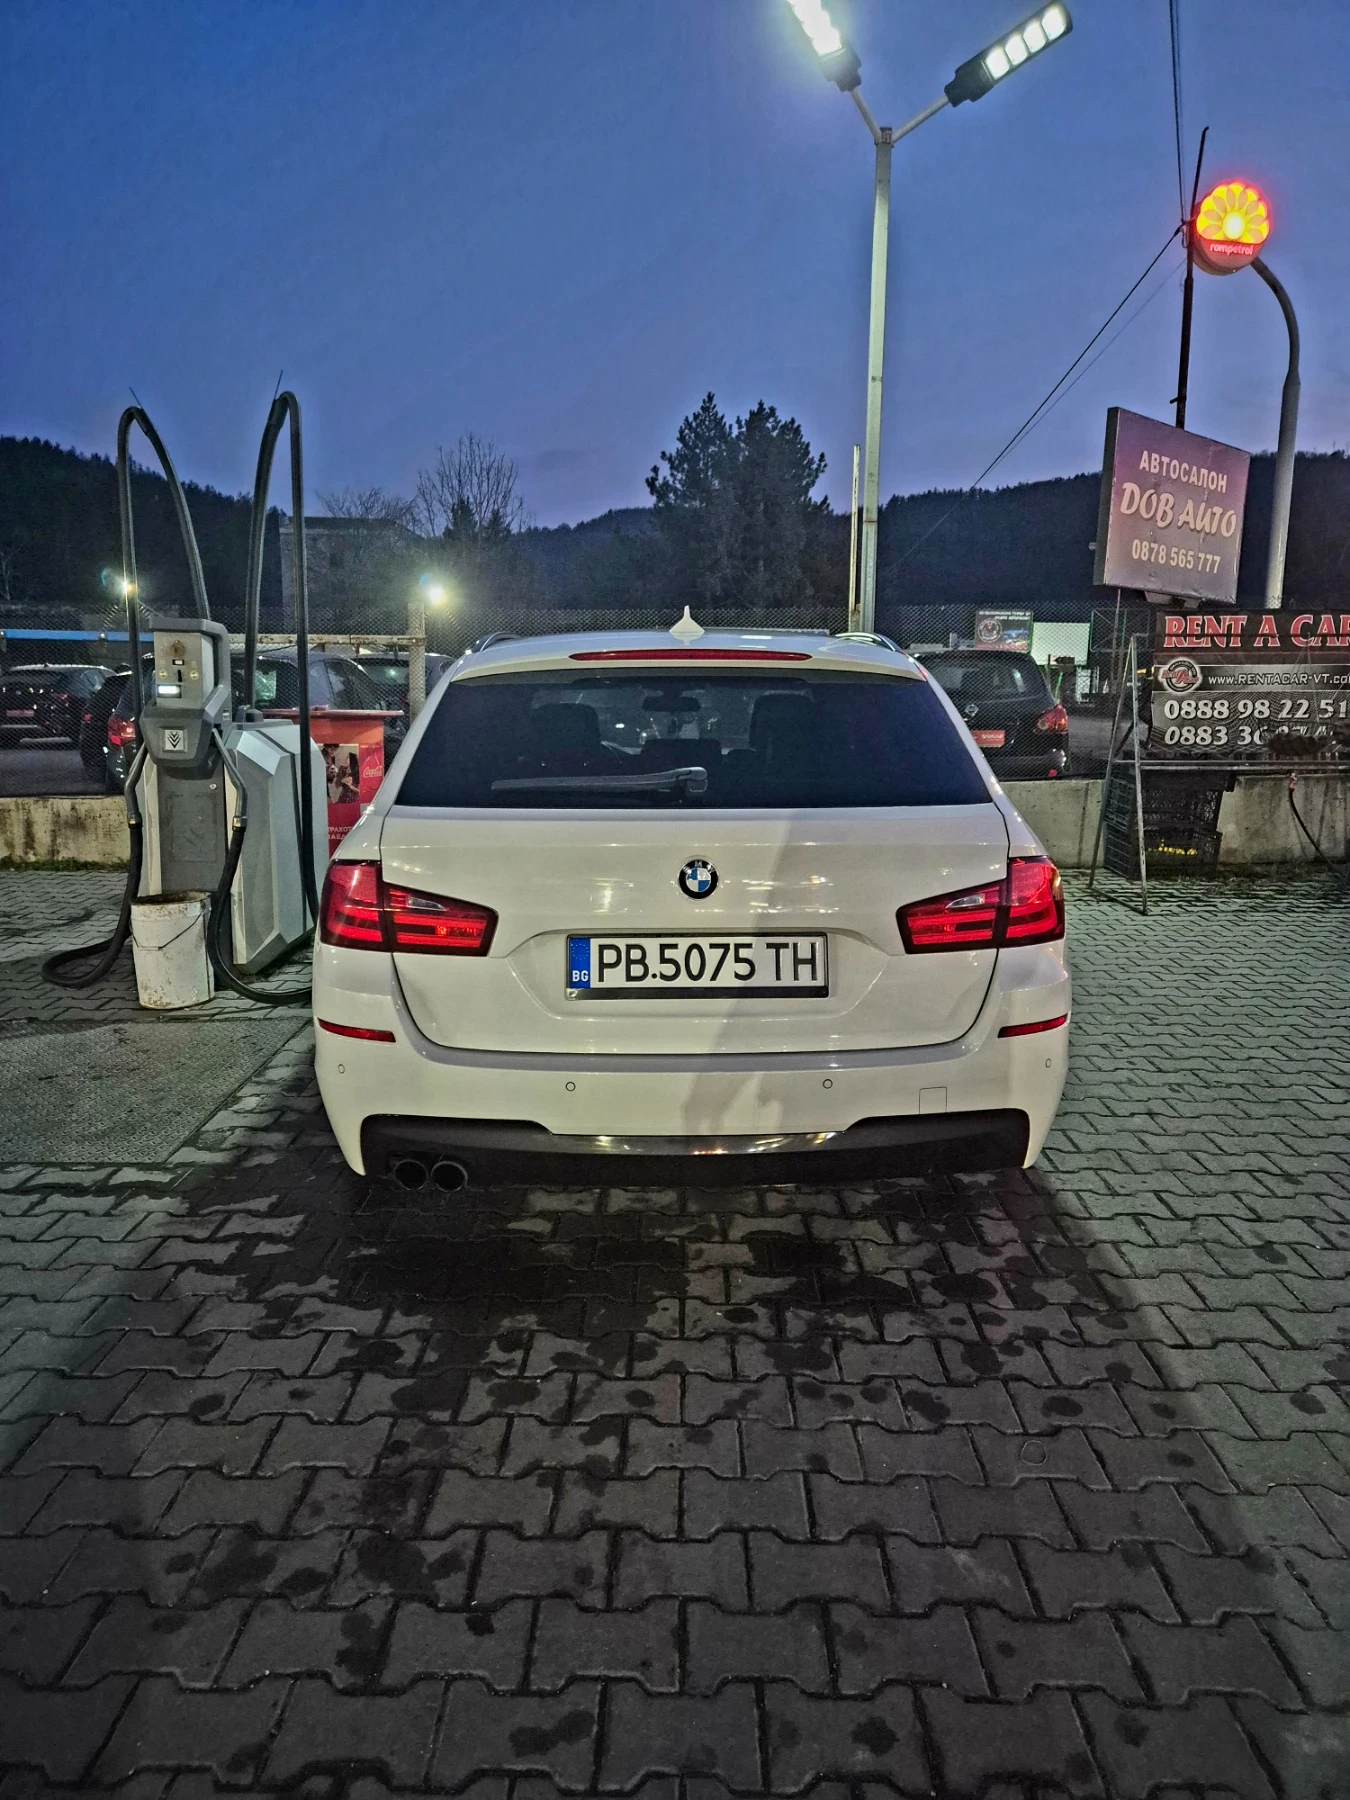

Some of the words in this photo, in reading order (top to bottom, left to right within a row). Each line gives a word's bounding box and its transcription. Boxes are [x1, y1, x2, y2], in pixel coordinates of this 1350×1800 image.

[1210, 243, 1254, 255] rompetrol
[1139, 450, 1228, 494] АВТОСАЛОН
[1132, 539, 1167, 565] 0878
[1170, 546, 1194, 570] 565
[1198, 552, 1221, 575] 777
[1163, 615, 1248, 648] RENT
[1253, 615, 1281, 647] A
[1208, 673, 1350, 685] www.RENTACAR-VT.co
[1164, 699, 1230, 720] 0888
[1237, 699, 1271, 720] 98
[1278, 699, 1310, 719] 22
[1318, 699, 1347, 718] 51
[1164, 726, 1229, 746] 0883
[572, 970, 589, 982] BG
[766, 942, 818, 982] TH
